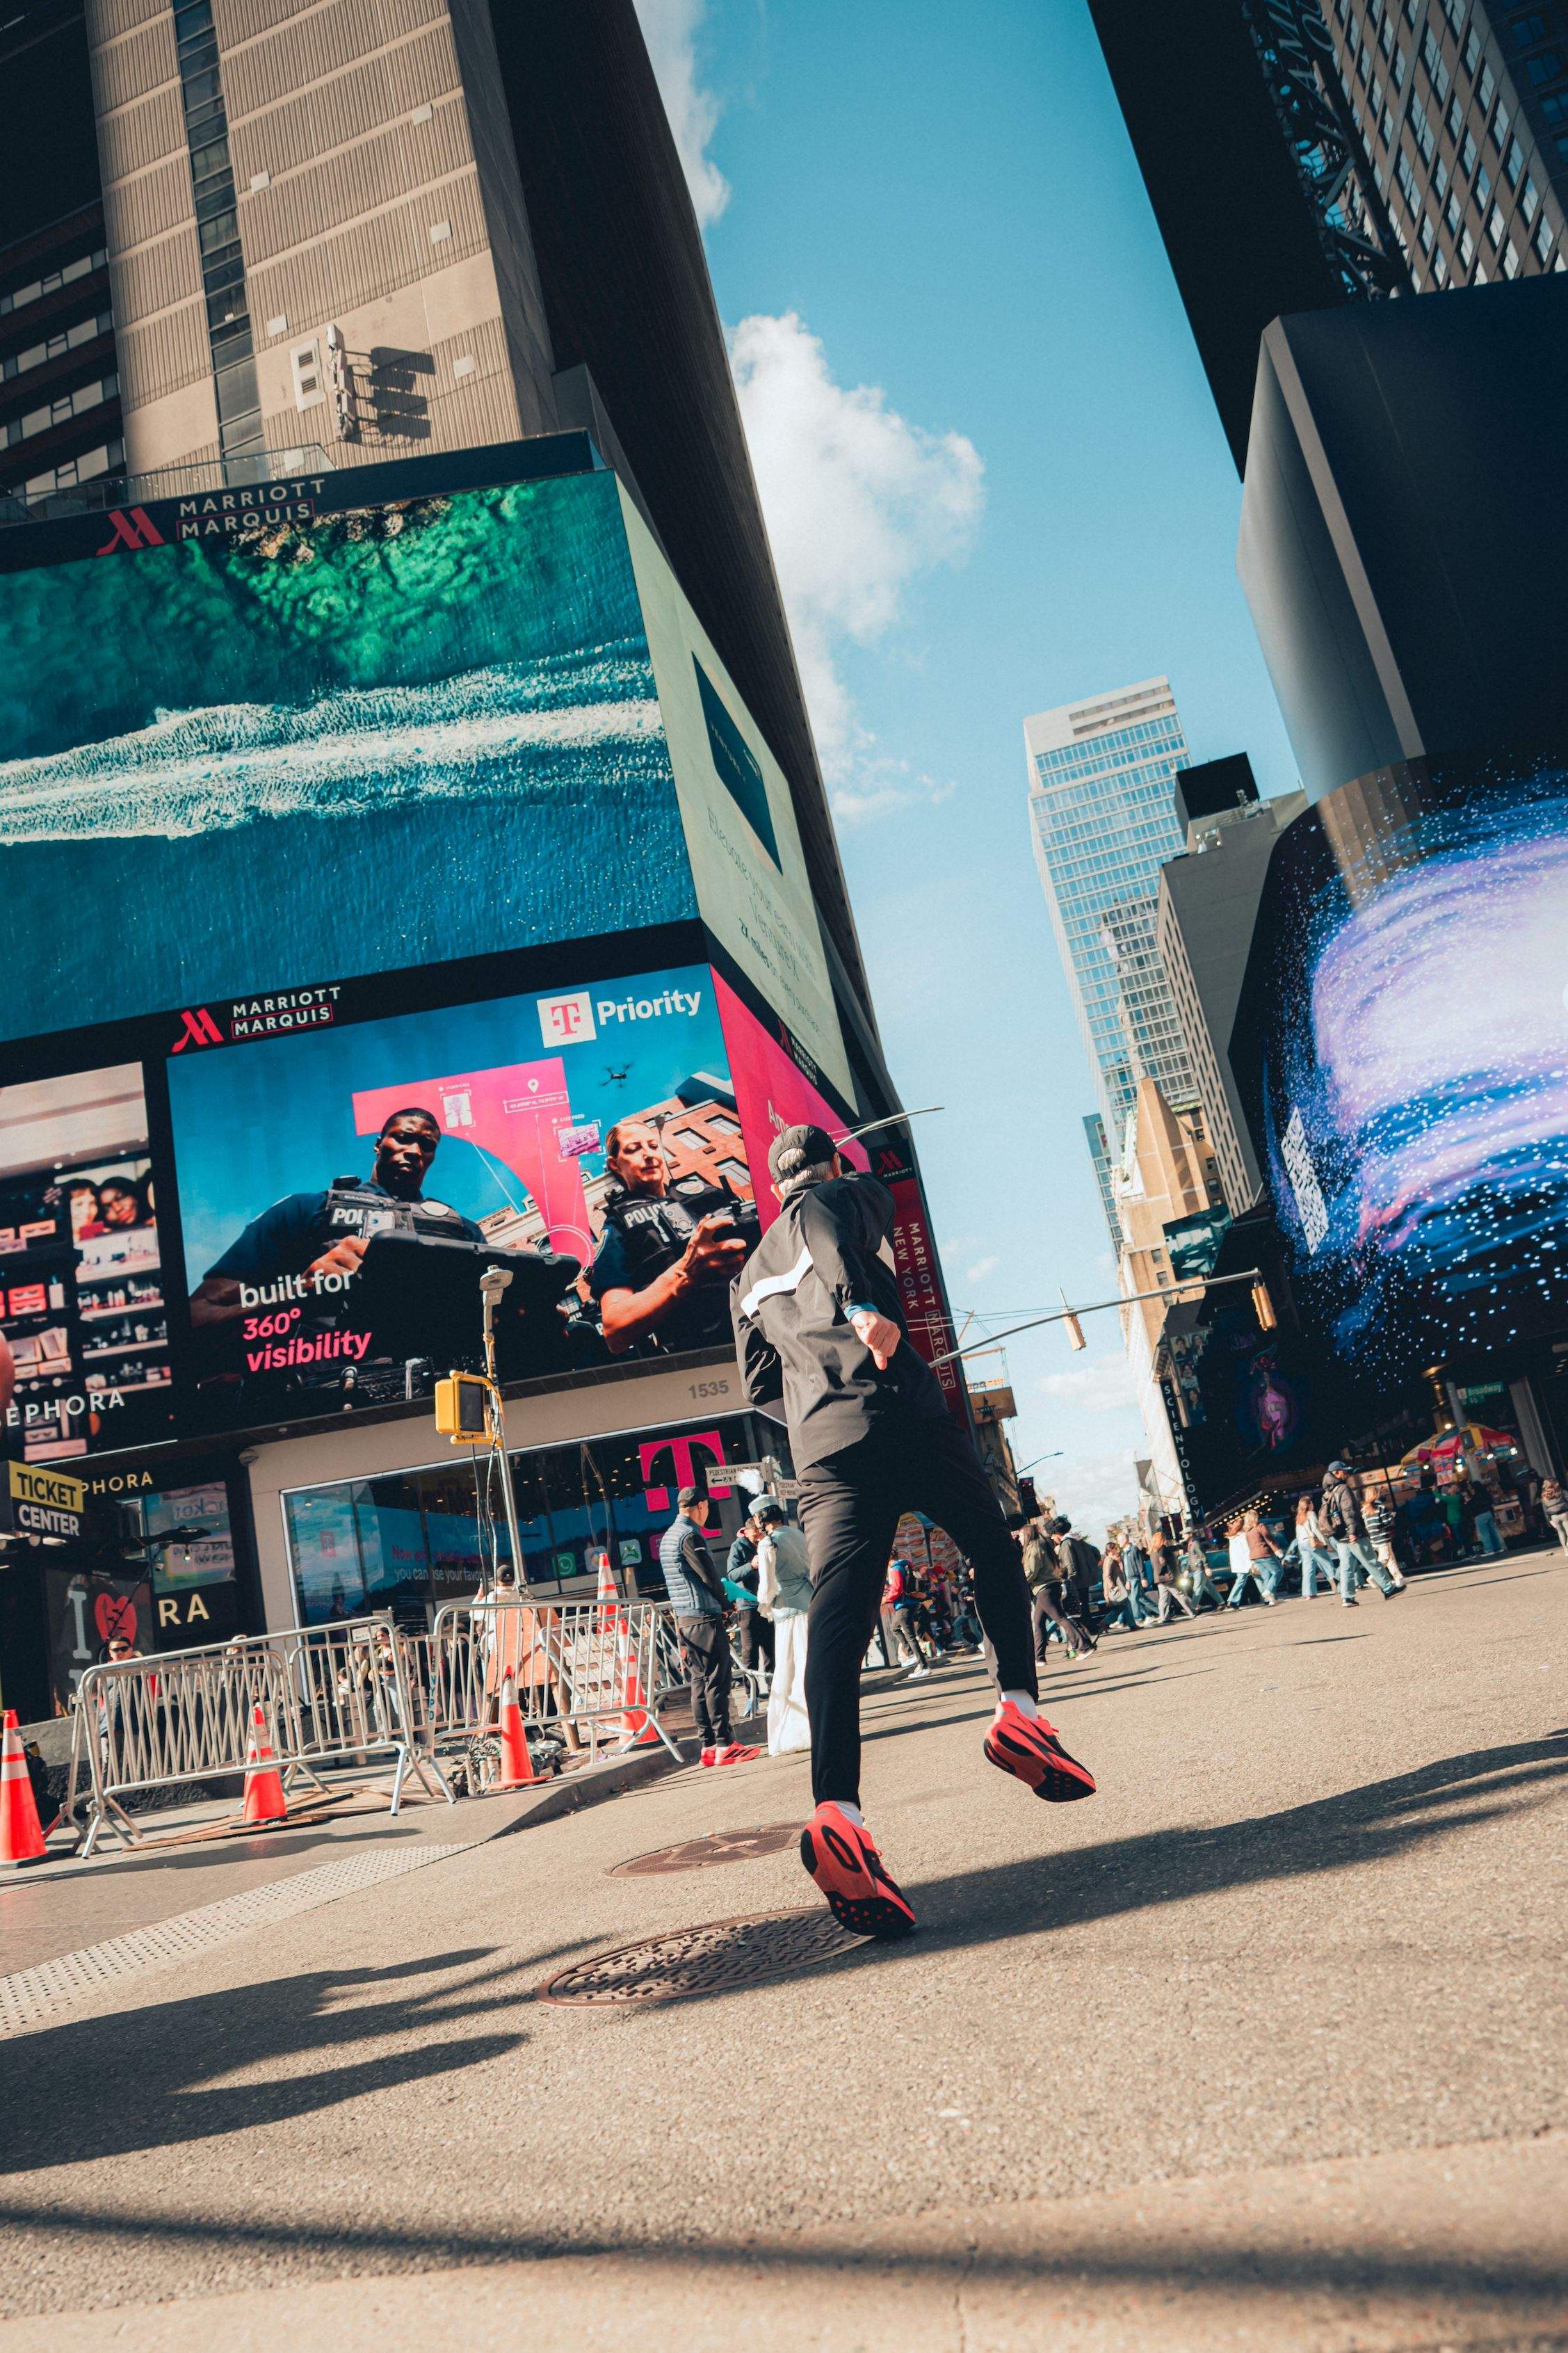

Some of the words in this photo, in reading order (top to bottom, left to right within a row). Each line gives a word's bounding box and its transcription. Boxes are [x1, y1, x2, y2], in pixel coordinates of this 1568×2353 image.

[180, 479, 325, 517] MARRIOTT
[182, 504, 311, 539] MARQUIS
[707, 806, 748, 881] Elevate
[749, 896, 791, 970] Venture
[750, 936, 770, 969] miles
[232, 986, 341, 1018] MARRIOTT
[597, 989, 702, 1026] Priority
[234, 1006, 330, 1036] MARQUIS
[790, 1036, 817, 1075] MARRIOTT
[882, 1167, 912, 1178] MARRIOTT
[894, 1227, 909, 1261] NEW
[239, 1274, 309, 1309] built
[310, 1269, 355, 1296] for
[901, 1267, 919, 1310] YORK
[908, 1222, 936, 1306] MARRIOTT
[928, 1312, 953, 1388] MARQUIS
[242, 1307, 301, 1341] 360°
[246, 1329, 372, 1372] visibility
[688, 1380, 729, 1399] 1535
[1468, 1384, 1501, 1397] Broadway
[0, 1389, 125, 1427] EPHORA
[1163, 1386, 1201, 1518] SCIENTOLOGY
[17, 1472, 76, 1507] TICKET
[81, 1471, 153, 1495] PHORA
[638, 1430, 732, 1539] T
[709, 1468, 737, 1476] PEDESTRIAN
[19, 1504, 80, 1536] CENTER
[394, 1568, 412, 1582] you
[412, 1567, 429, 1580] can
[444, 1568, 463, 1584] your
